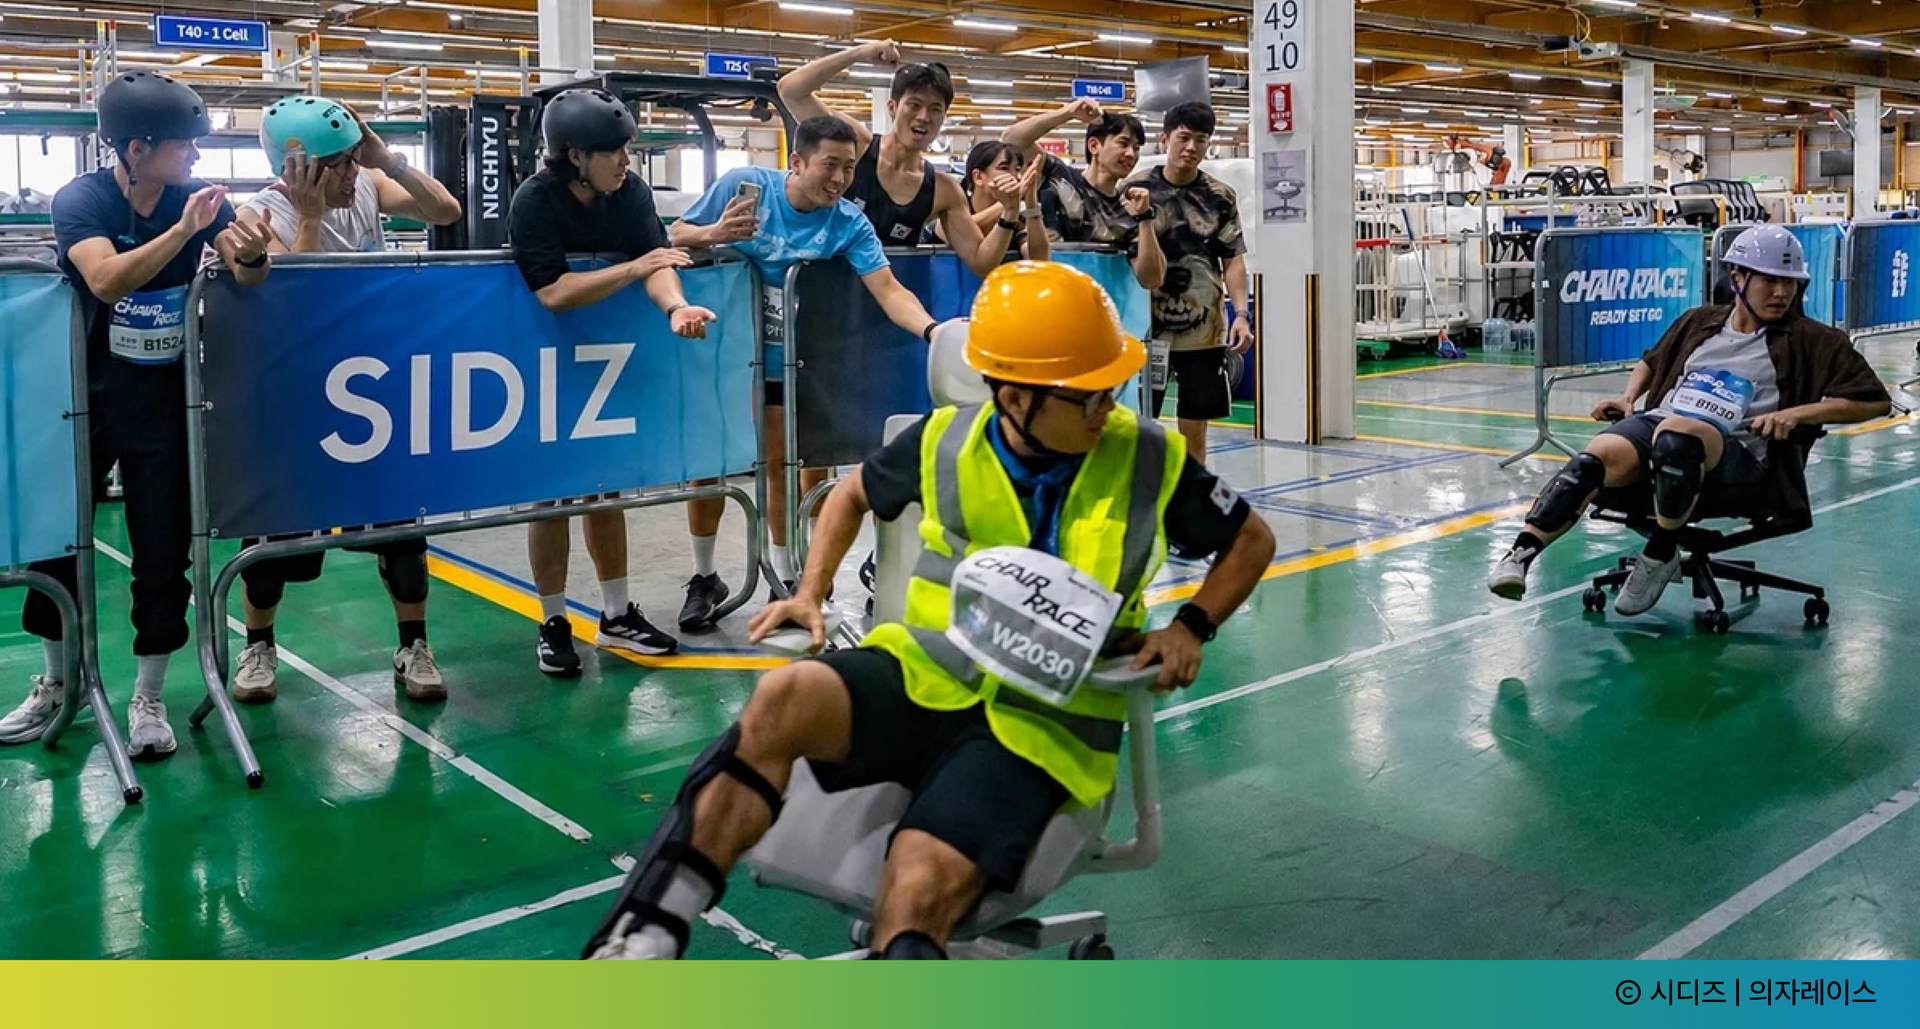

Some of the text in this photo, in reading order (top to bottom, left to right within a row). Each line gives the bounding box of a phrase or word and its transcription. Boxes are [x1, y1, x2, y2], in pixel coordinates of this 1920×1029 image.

[177, 24, 202, 39] T40
[211, 27, 221, 40] 1
[223, 28, 249, 41] Cell
[1263, 0, 1298, 31] 49
[1265, 41, 1299, 72] 10
[482, 116, 499, 220] NICHIYU
[1560, 267, 1688, 303] CHAIR RACE
[1590, 307, 1663, 327] READY SET GO
[319, 343, 637, 463] SIDIZ
[974, 556, 1051, 595] CHAIR
[1022, 591, 1096, 640] RACE
[991, 620, 1075, 681] W2030
